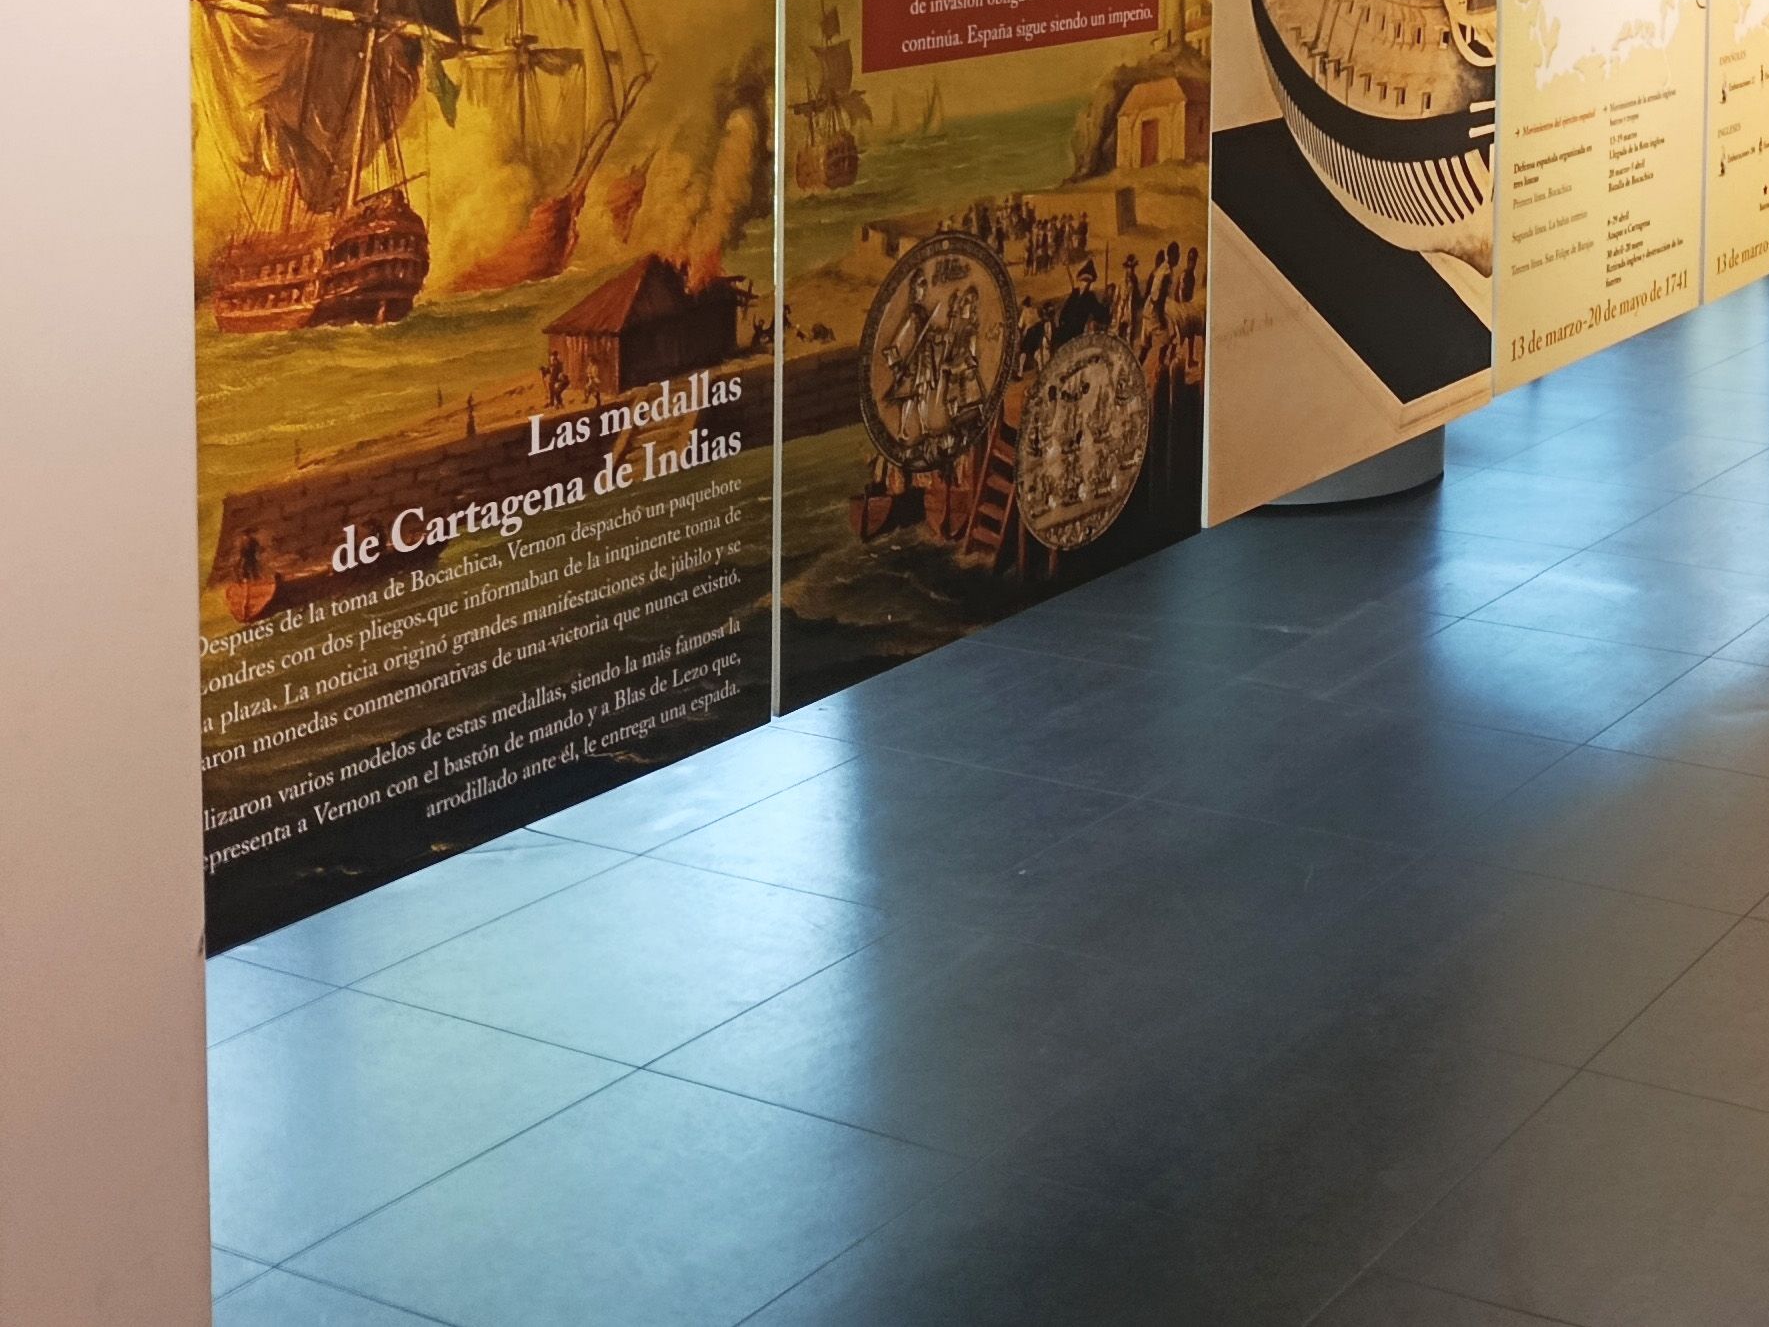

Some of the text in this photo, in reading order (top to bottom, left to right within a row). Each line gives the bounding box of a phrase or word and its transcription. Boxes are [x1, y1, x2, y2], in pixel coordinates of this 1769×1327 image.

[1511, 335, 1525, 361] 13
[1528, 330, 1542, 354] de
[1603, 299, 1616, 322] de
[1619, 292, 1648, 316] mayo
[1650, 280, 1662, 302] de
[1665, 270, 1688, 296] 1741
[1716, 253, 1727, 275] 13
[1728, 247, 1739, 269] de
[527, 368, 741, 455] Las medallas
[275, 609, 302, 632] de
[308, 602, 325, 623] la
[330, 590, 378, 616] toma
[383, 577, 404, 600] de
[410, 553, 502, 591] Bocachica,
[508, 533, 565, 559] Vernon
[571, 505, 641, 541] despachó
[645, 502, 664, 517] un
[669, 479, 741, 517] paquebote
[329, 429, 741, 571] de Cartagena de Indias
[220, 698, 277, 734] plaza.
[284, 683, 309, 706] La
[315, 659, 378, 694] noticia
[383, 634, 447, 670] originó
[453, 614, 517, 654] grandes
[522, 573, 644, 624] manifestaciones
[649, 561, 666, 581] de
[671, 547, 711, 579] júbilo
[714, 546, 723, 564] y
[727, 541, 740, 554] se
[252, 711, 338, 752] monedas
[343, 660, 486, 720] conmemorativas
[492, 647, 511, 668] de
[548, 614, 608, 646] victoria
[613, 606, 640, 630] que
[645, 589, 688, 614] nunca
[692, 568, 740, 597] existió.
[278, 771, 334, 802] varios
[340, 741, 415, 780] modelos
[420, 728, 441, 749] de
[446, 715, 486, 739] estas
[492, 686, 566, 723] medallas,
[570, 662, 620, 693] siendo
[625, 655, 637, 673] la
[642, 644, 670, 667] más
[676, 625, 726, 654] famosa
[728, 617, 740, 634] la
[426, 679, 740, 817] arrodillado ante él, le entrega una espada.
